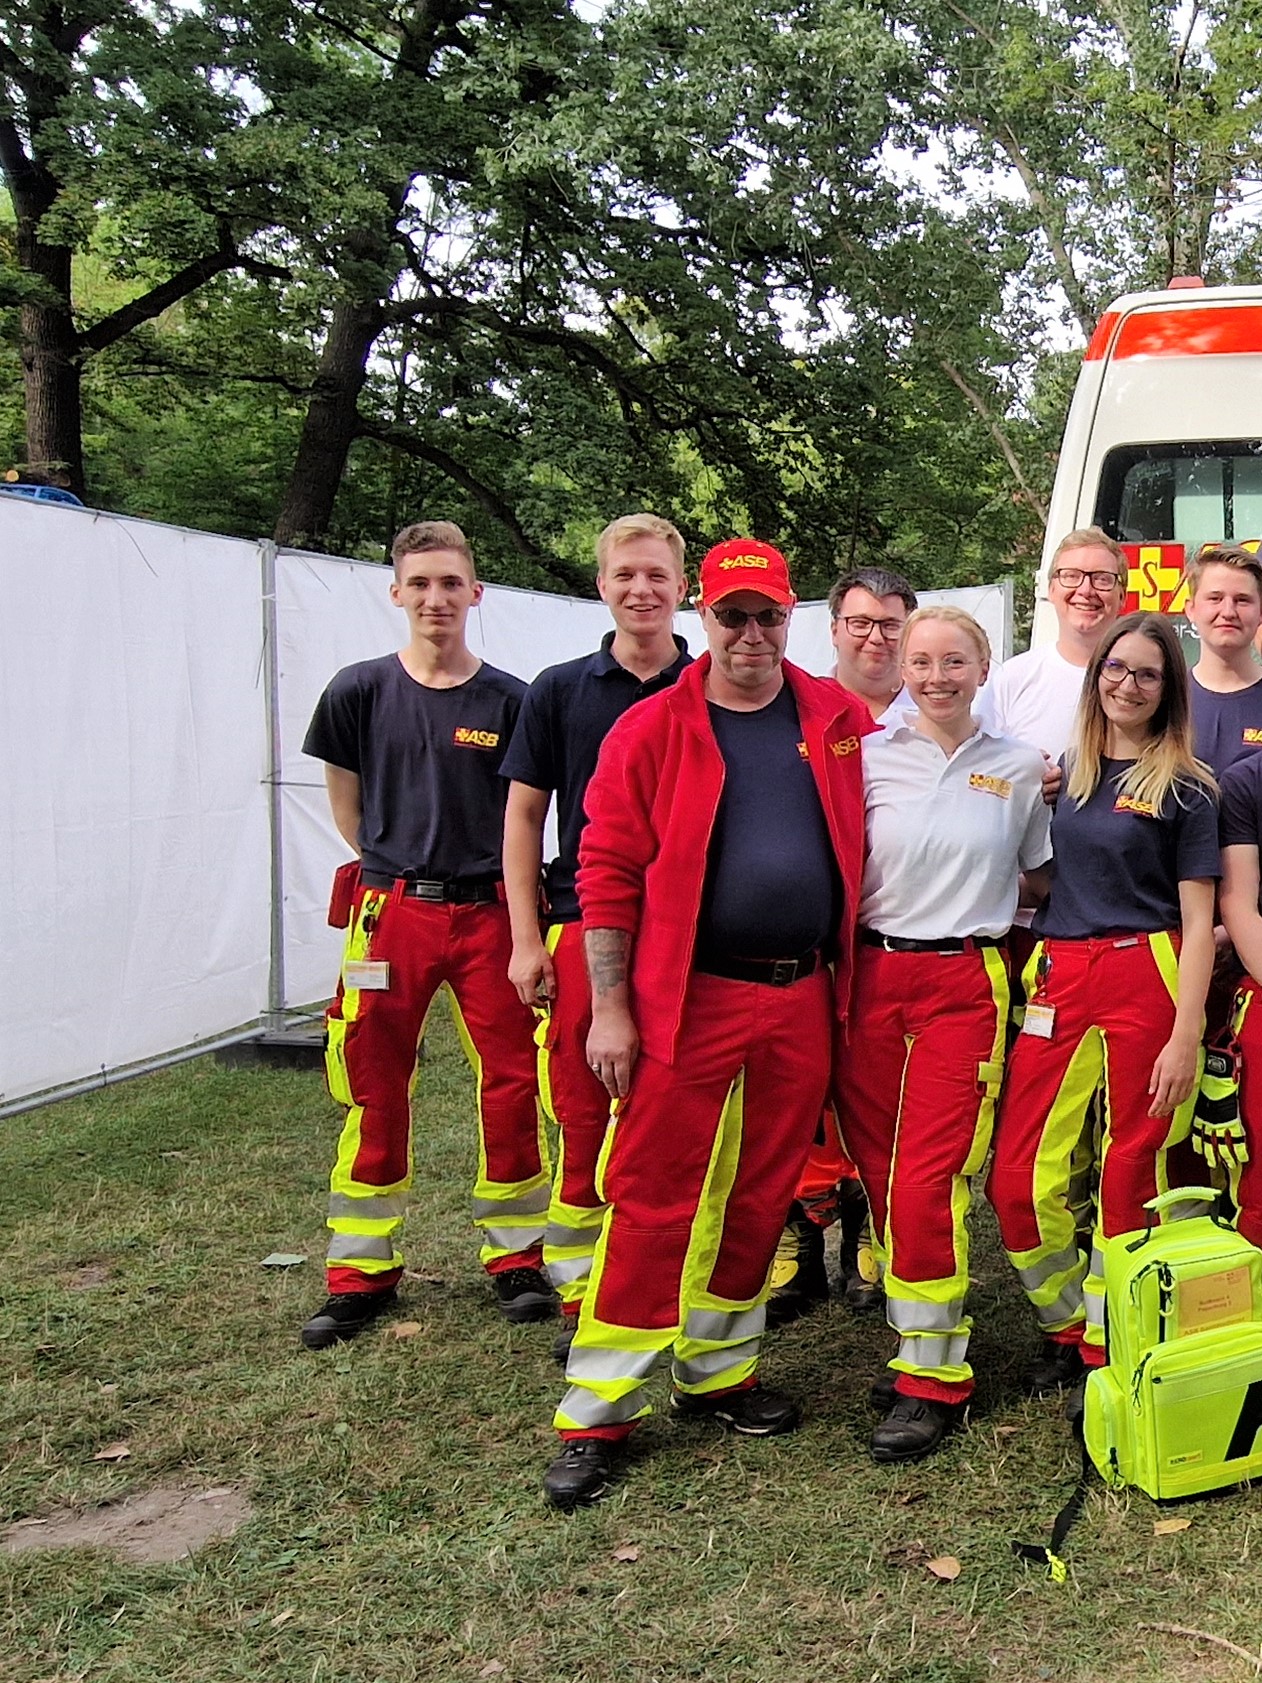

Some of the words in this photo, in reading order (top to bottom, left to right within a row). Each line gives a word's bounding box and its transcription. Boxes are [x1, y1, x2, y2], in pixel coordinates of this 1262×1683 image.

[731, 555, 769, 569] ASB
[1142, 561, 1158, 598] S
[465, 730, 500, 747] ASB
